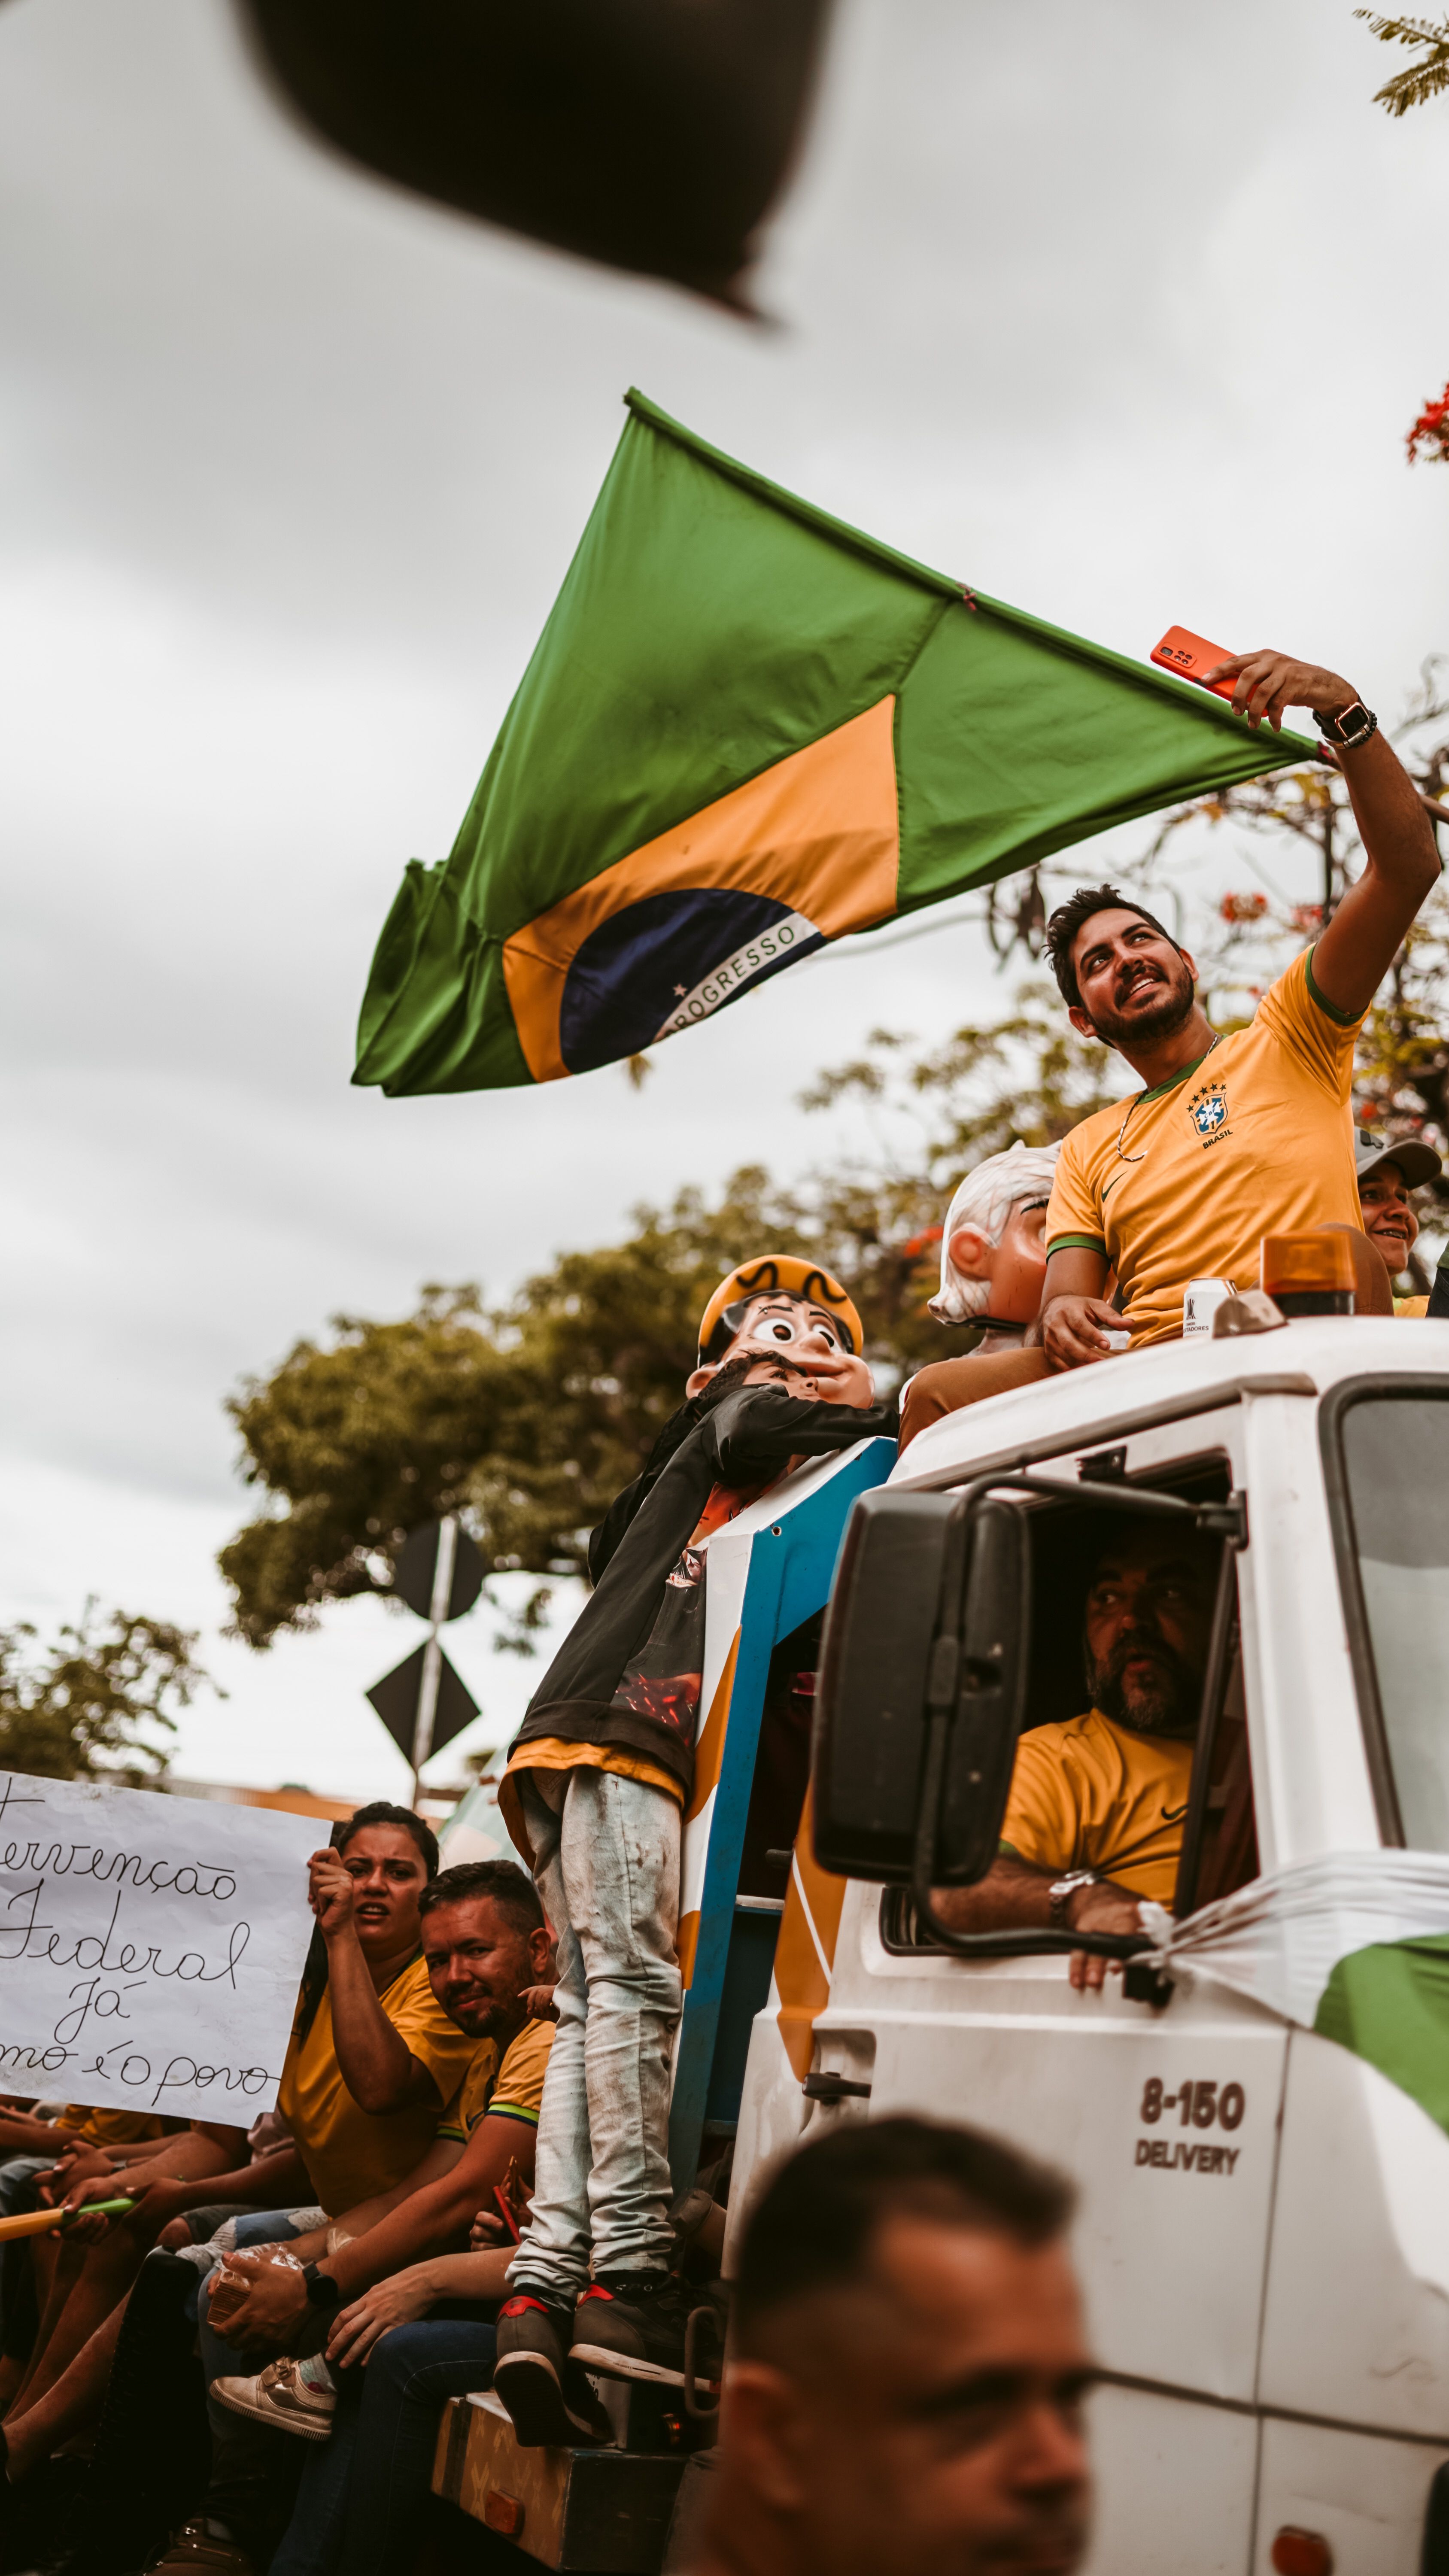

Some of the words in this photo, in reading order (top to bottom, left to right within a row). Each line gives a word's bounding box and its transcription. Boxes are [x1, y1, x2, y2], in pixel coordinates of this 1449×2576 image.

[1204, 1107, 1215, 1118] CBF
[1203, 1129, 1233, 1149] BRASIL
[0, 1878, 250, 1990] Federal
[152, 2057, 282, 2106] povo
[1140, 2076, 1245, 2132] 8-150
[1134, 2139, 1240, 2176] DELIVERY
